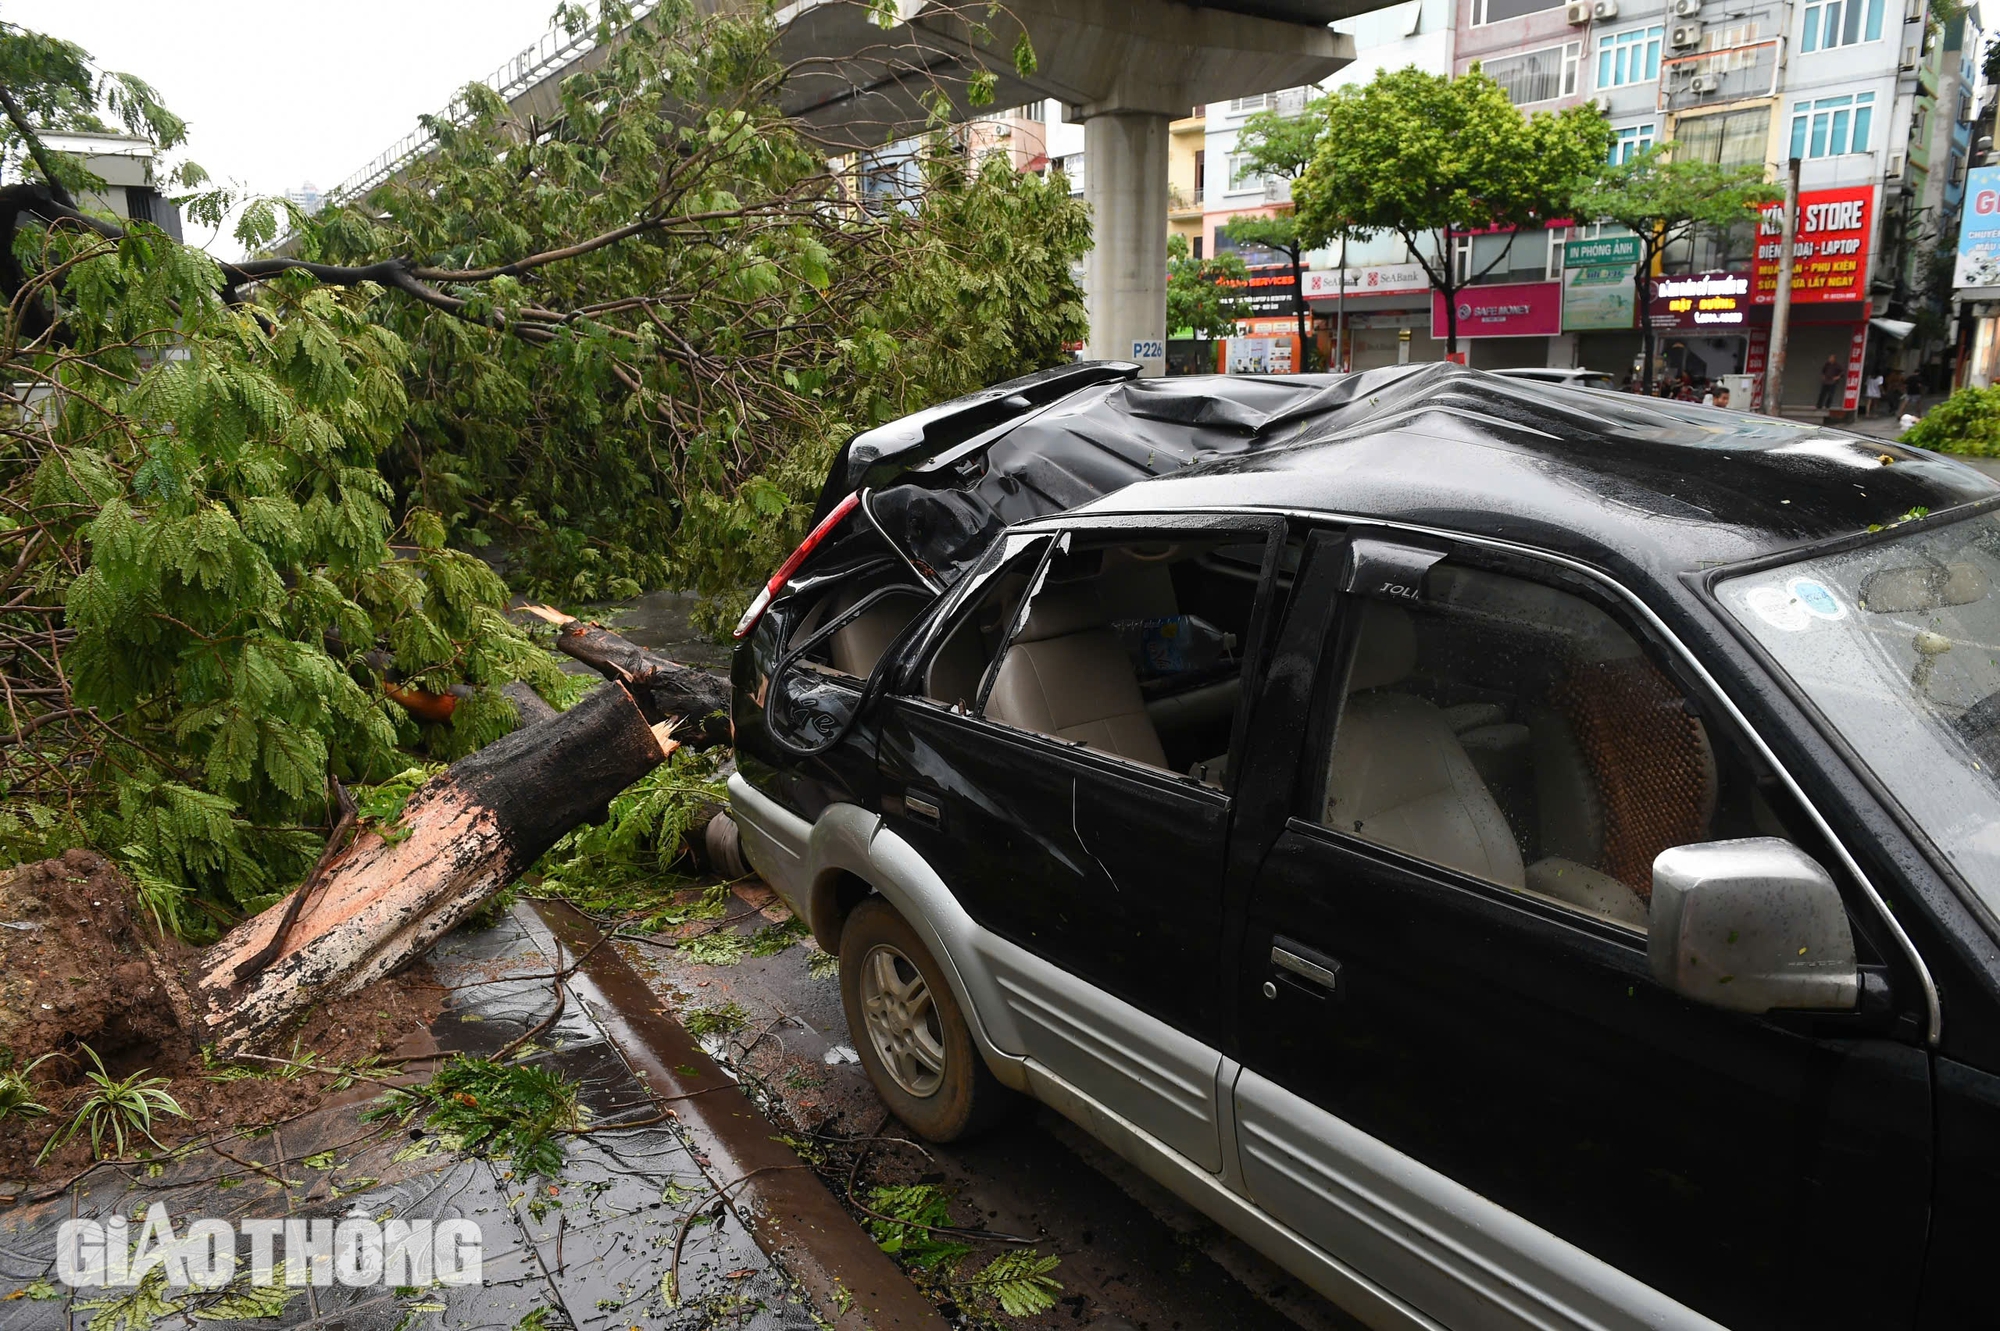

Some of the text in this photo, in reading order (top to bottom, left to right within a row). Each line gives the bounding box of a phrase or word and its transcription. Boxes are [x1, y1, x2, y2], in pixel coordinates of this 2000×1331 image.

[1805, 200, 1864, 232] STORE
[1569, 239, 1633, 258] IN PHÓNG ẢNH
[1821, 238, 1860, 256] LAPTOP
[1810, 262, 1831, 275] PHỤ
[1832, 259, 1857, 275] KIỆN
[1249, 276, 1296, 287] SERVICES
[1380, 271, 1419, 283] SeABank
[1807, 275, 1826, 288] LẤY
[1827, 276, 1855, 287] NGAY
[1474, 305, 1530, 316] SAFE MONEY
[1133, 342, 1162, 358] P226
[1380, 582, 1419, 600] JOLI
